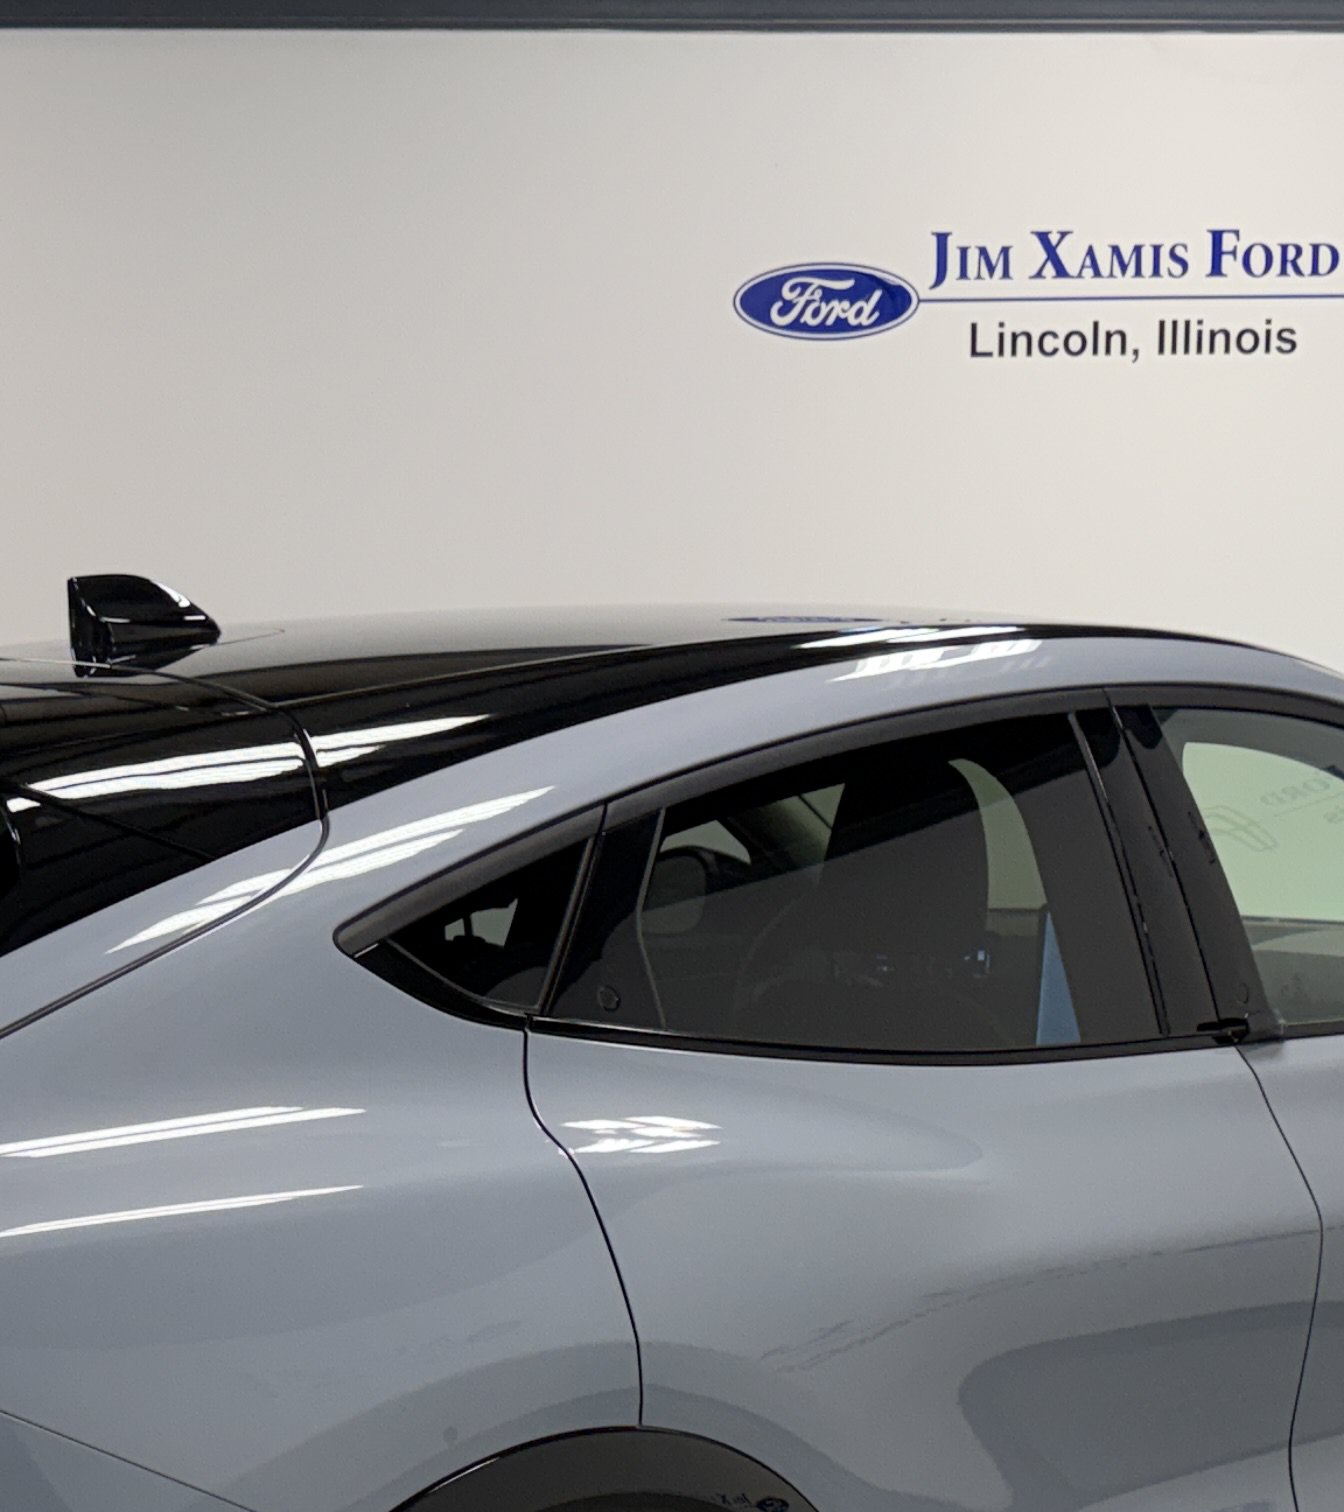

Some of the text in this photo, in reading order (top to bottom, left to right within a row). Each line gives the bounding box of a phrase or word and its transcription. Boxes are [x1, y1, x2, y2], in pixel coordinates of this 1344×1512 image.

[928, 228, 1341, 290] JIM XAMIS FORD
[769, 275, 883, 328] Ford
[969, 319, 1298, 363] Lincoln, Illinois
